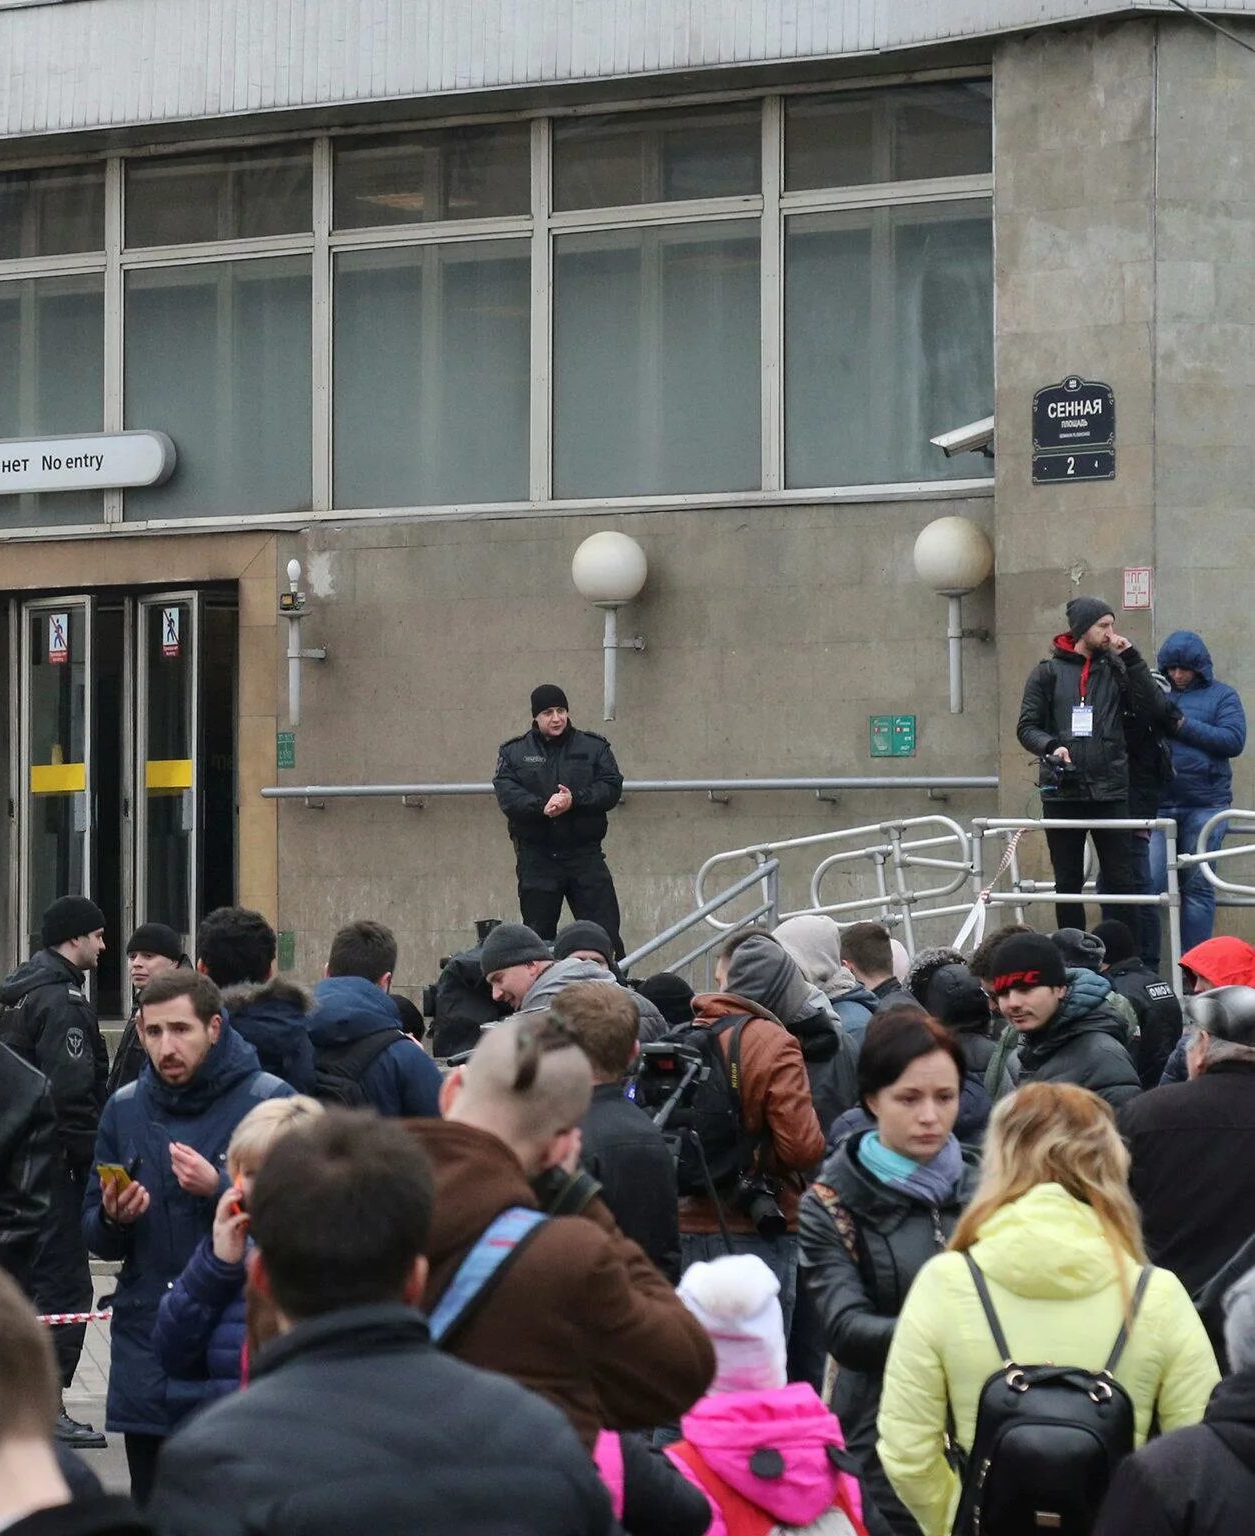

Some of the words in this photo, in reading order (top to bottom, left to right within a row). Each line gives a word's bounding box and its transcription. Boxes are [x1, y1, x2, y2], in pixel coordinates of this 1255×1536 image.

[1047, 398, 1102, 419] СЕННАЯ
[1, 458, 29, 474] нет
[42, 455, 63, 471] No
[66, 453, 104, 472] entry
[1067, 456, 1075, 475] 2
